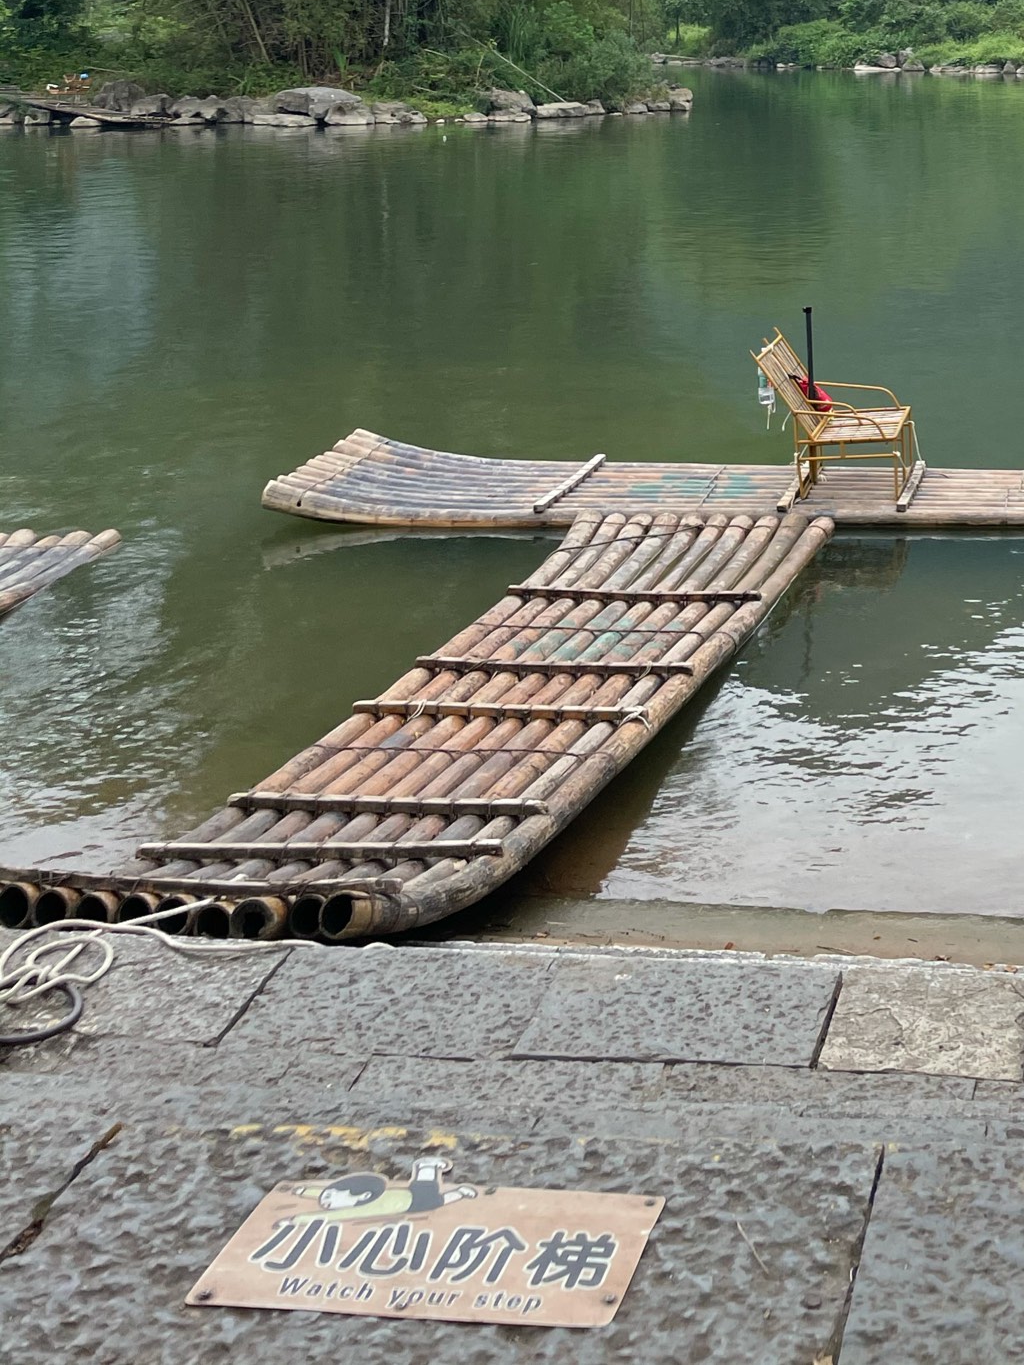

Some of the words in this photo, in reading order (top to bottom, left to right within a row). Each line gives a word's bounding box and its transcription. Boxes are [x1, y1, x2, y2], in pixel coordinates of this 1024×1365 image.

[250, 1218, 617, 1289] 小心阶梯
[277, 1277, 374, 1301] Watch
[388, 1287, 458, 1309] your
[473, 1294, 542, 1314] step
